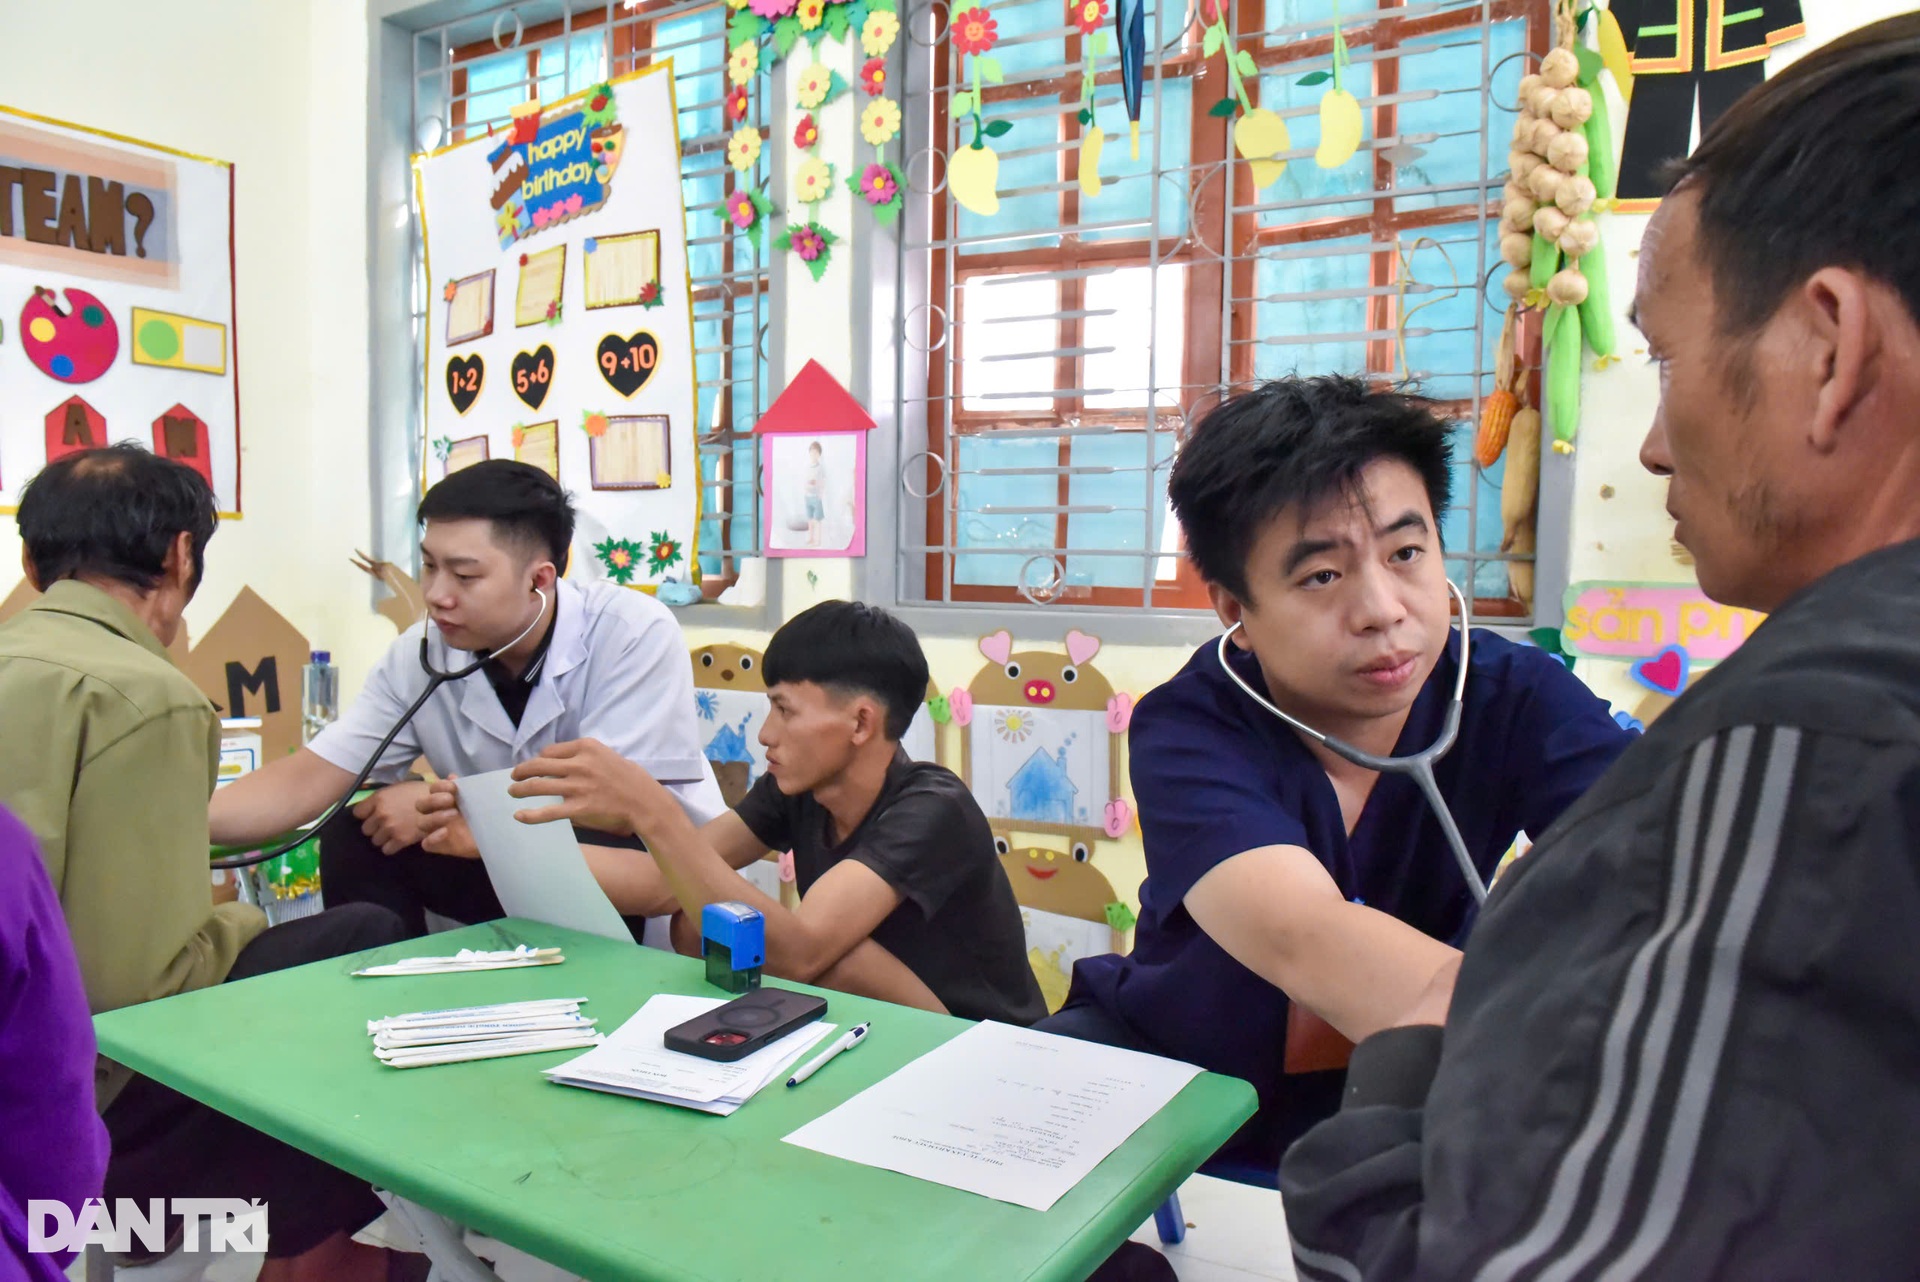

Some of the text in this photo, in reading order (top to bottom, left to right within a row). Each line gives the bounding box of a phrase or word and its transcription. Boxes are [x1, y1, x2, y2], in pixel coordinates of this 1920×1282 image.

[527, 127, 586, 165] happy
[522, 162, 593, 200] birthday
[516, 359, 549, 393] 5+6
[601, 344, 655, 376] 9+10
[452, 368, 477, 394] 1+2
[62, 404, 93, 446] A
[164, 415, 198, 458] M
[209, 656, 281, 718] M
